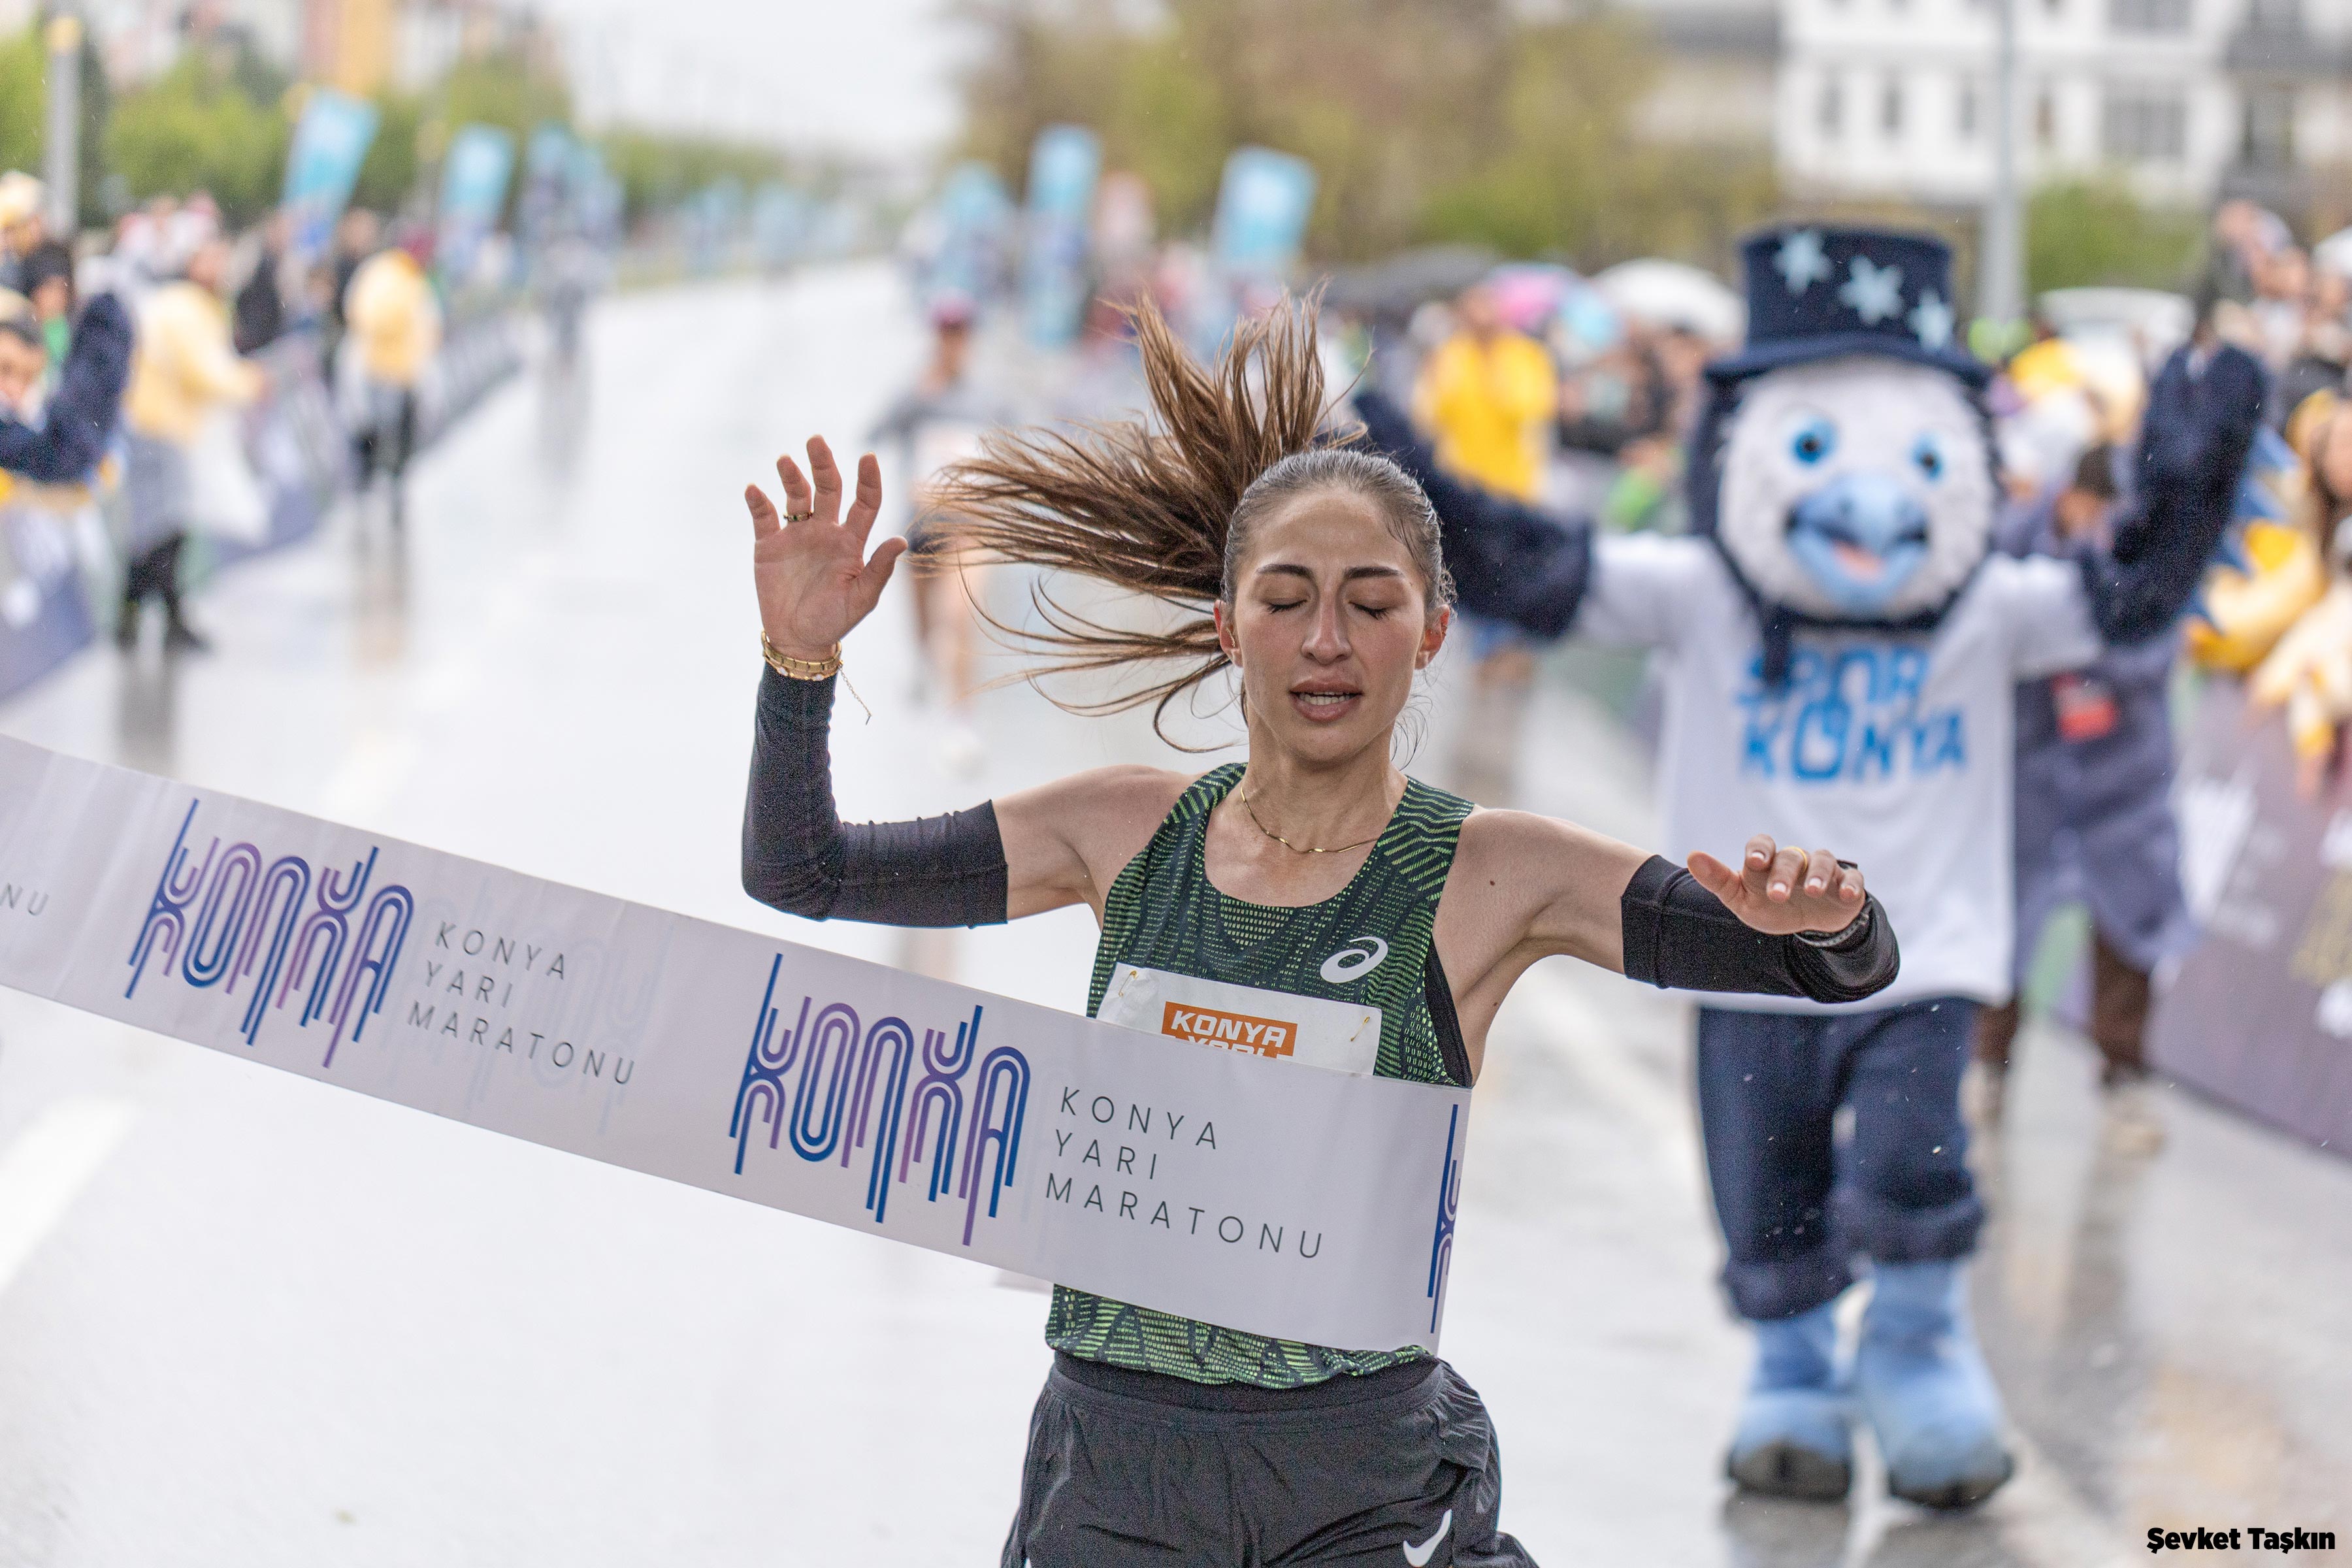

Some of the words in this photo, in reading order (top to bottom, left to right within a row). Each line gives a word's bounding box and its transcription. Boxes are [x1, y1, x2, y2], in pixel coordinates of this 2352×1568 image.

[1740, 702, 1967, 783] KONYA
[125, 798, 415, 1069] KONYA
[436, 921, 565, 979] KONYA
[425, 960, 513, 1007] YARI
[407, 1000, 635, 1085] MARATONU
[1171, 1010, 1288, 1048] KONYA
[728, 953, 1031, 1247] KONYA
[1060, 1086, 1217, 1150] KONYA
[1055, 1129, 1157, 1180] YARI
[1045, 1173, 1322, 1258] MARATONU
